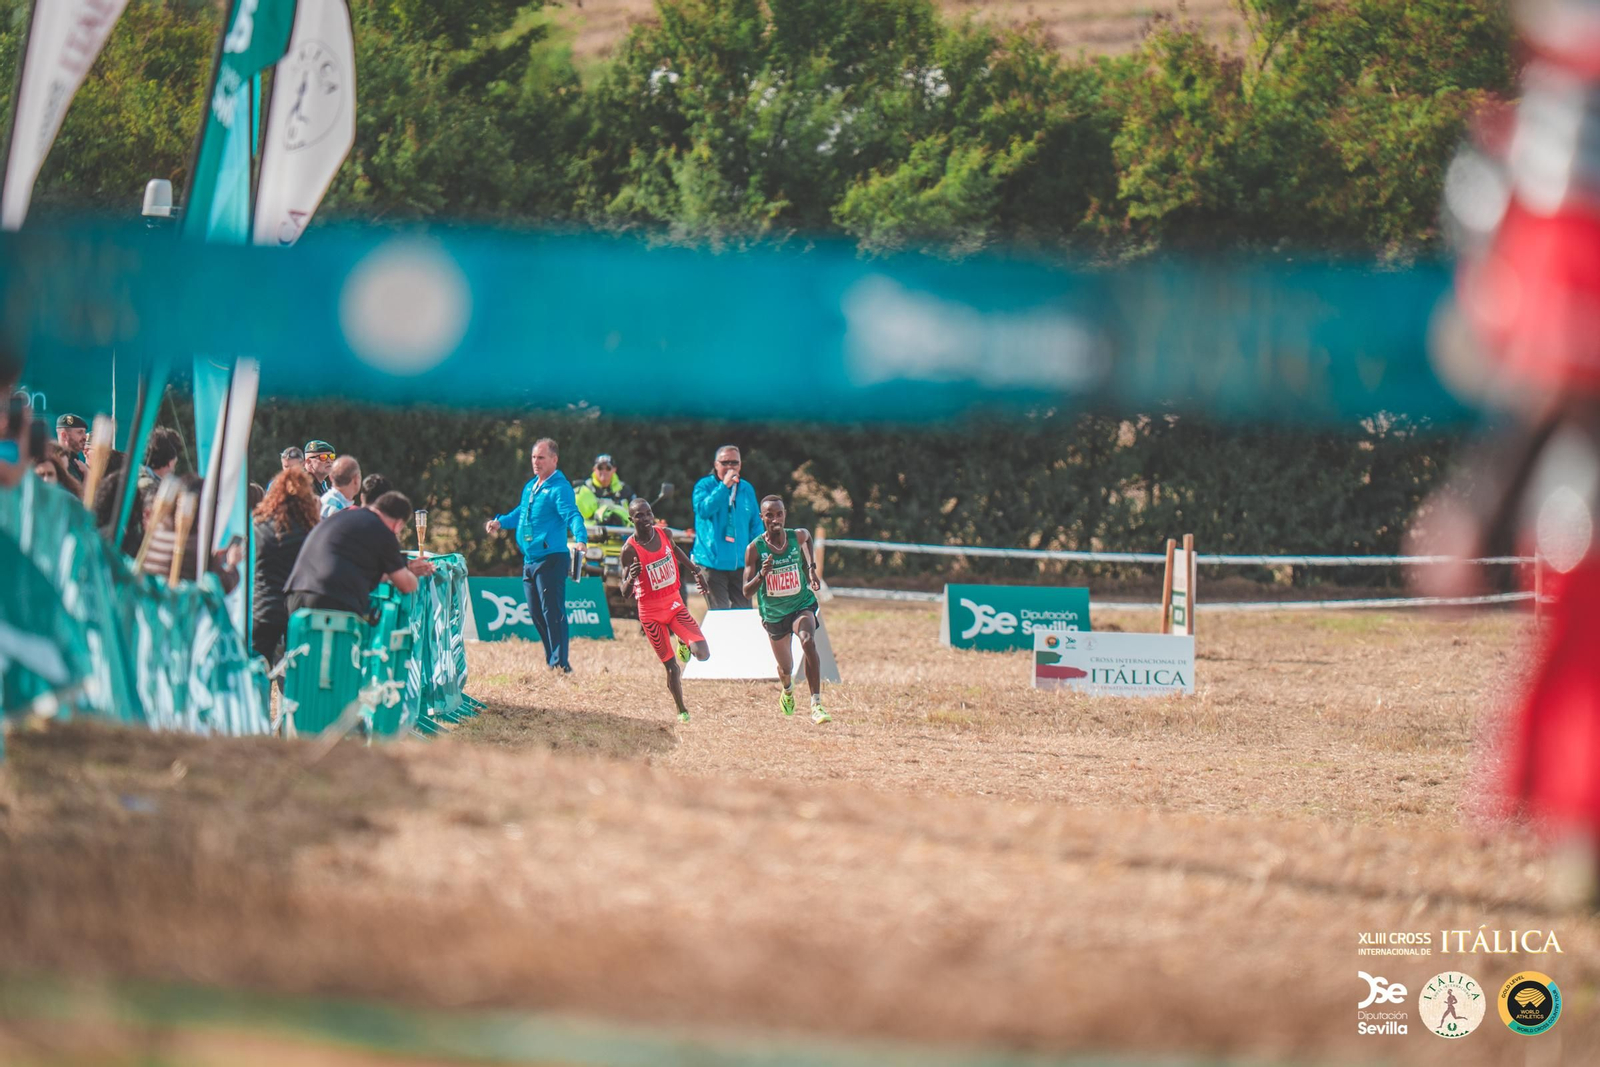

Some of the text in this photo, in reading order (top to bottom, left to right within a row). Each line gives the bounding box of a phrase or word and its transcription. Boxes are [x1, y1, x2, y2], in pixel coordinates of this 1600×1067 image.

[766, 571, 799, 591] KWIZERA
[1020, 609, 1078, 621] Diputación
[1115, 657, 1175, 665] INTERNACIONAL
[1091, 664, 1186, 686] ITÁLICA
